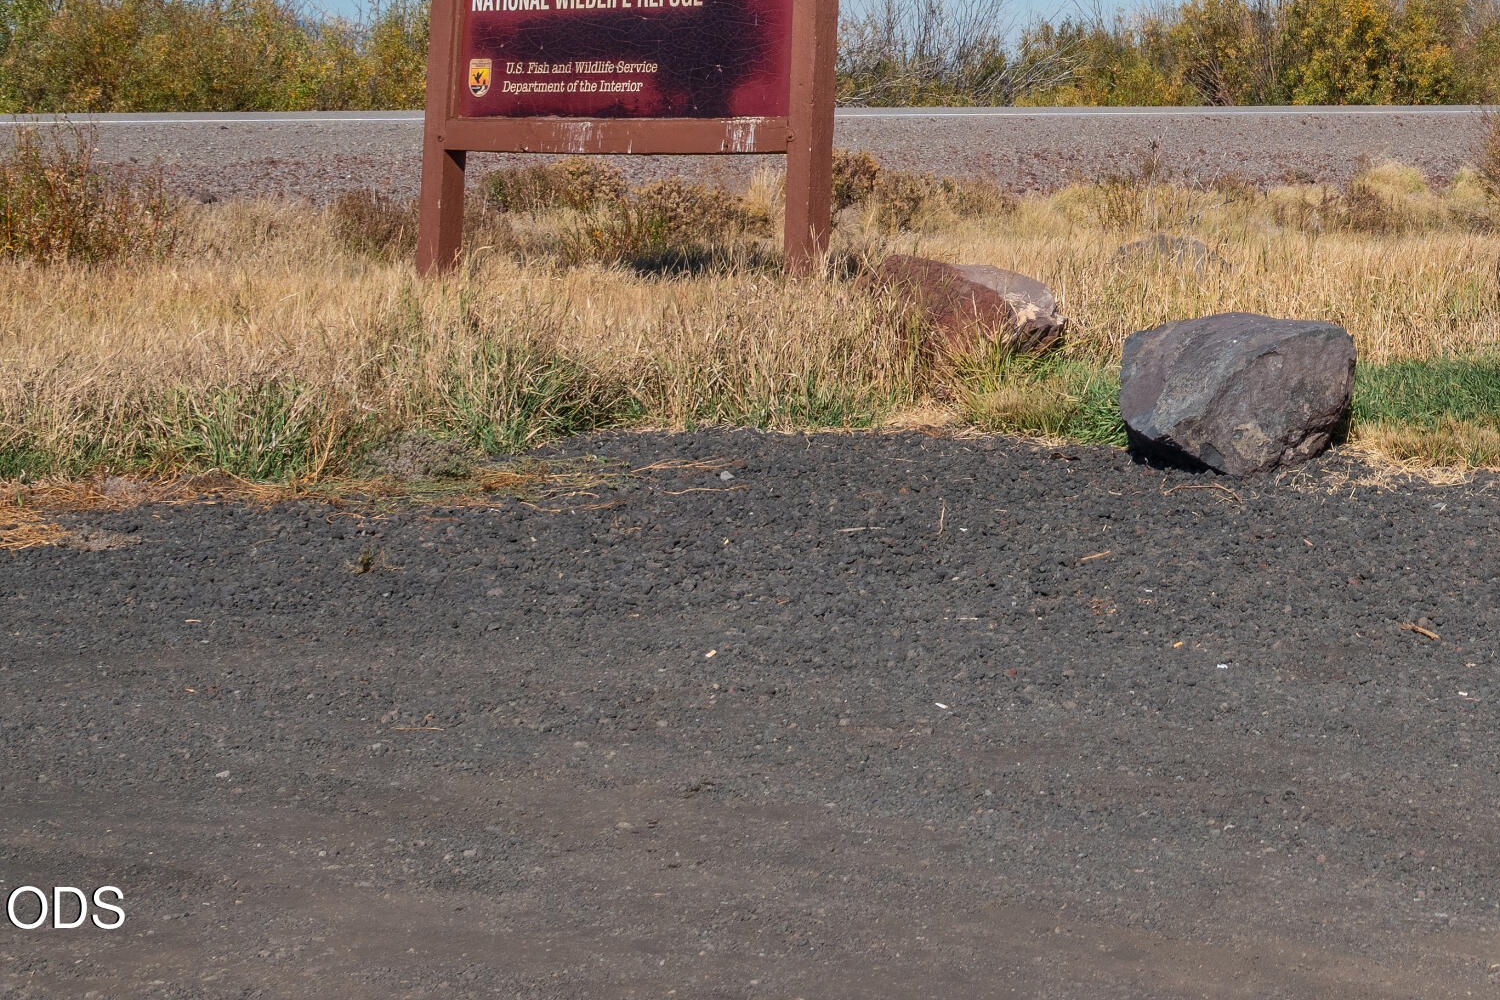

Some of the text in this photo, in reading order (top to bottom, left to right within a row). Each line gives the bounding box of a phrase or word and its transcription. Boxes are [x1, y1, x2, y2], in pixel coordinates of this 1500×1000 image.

[506, 62, 524, 74] U.S.
[527, 61, 550, 74] Fish
[551, 61, 572, 74] and
[575, 60, 616, 74] Wildlife
[617, 60, 658, 73] Service
[502, 79, 644, 95] Department of the Interior
